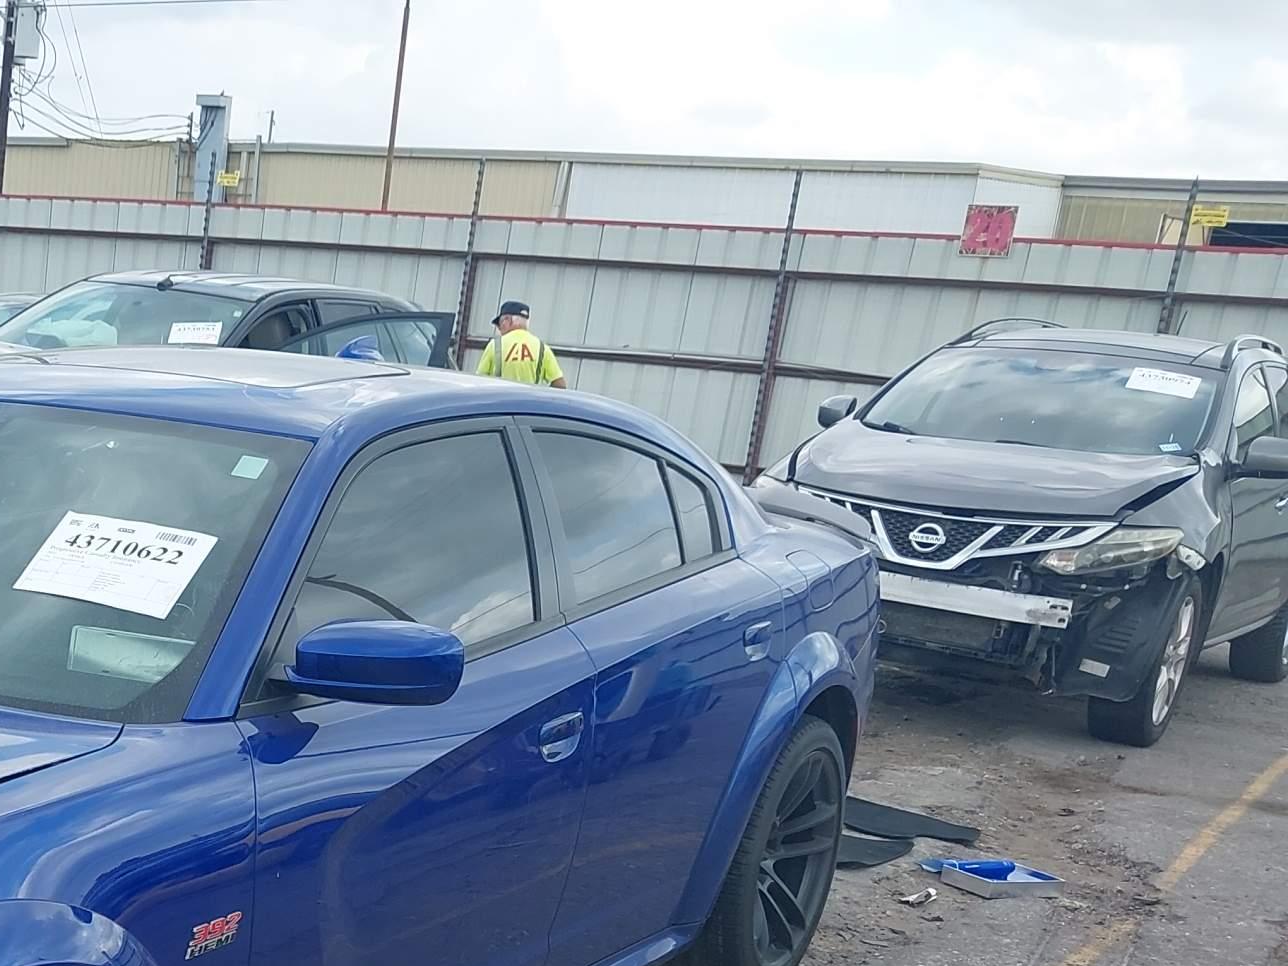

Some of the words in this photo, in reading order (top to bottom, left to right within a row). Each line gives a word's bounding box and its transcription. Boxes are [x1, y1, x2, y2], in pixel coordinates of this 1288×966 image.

[65, 533, 183, 565] 43710622
[912, 534, 941, 542] NISSAN
[192, 911, 242, 947] 392
